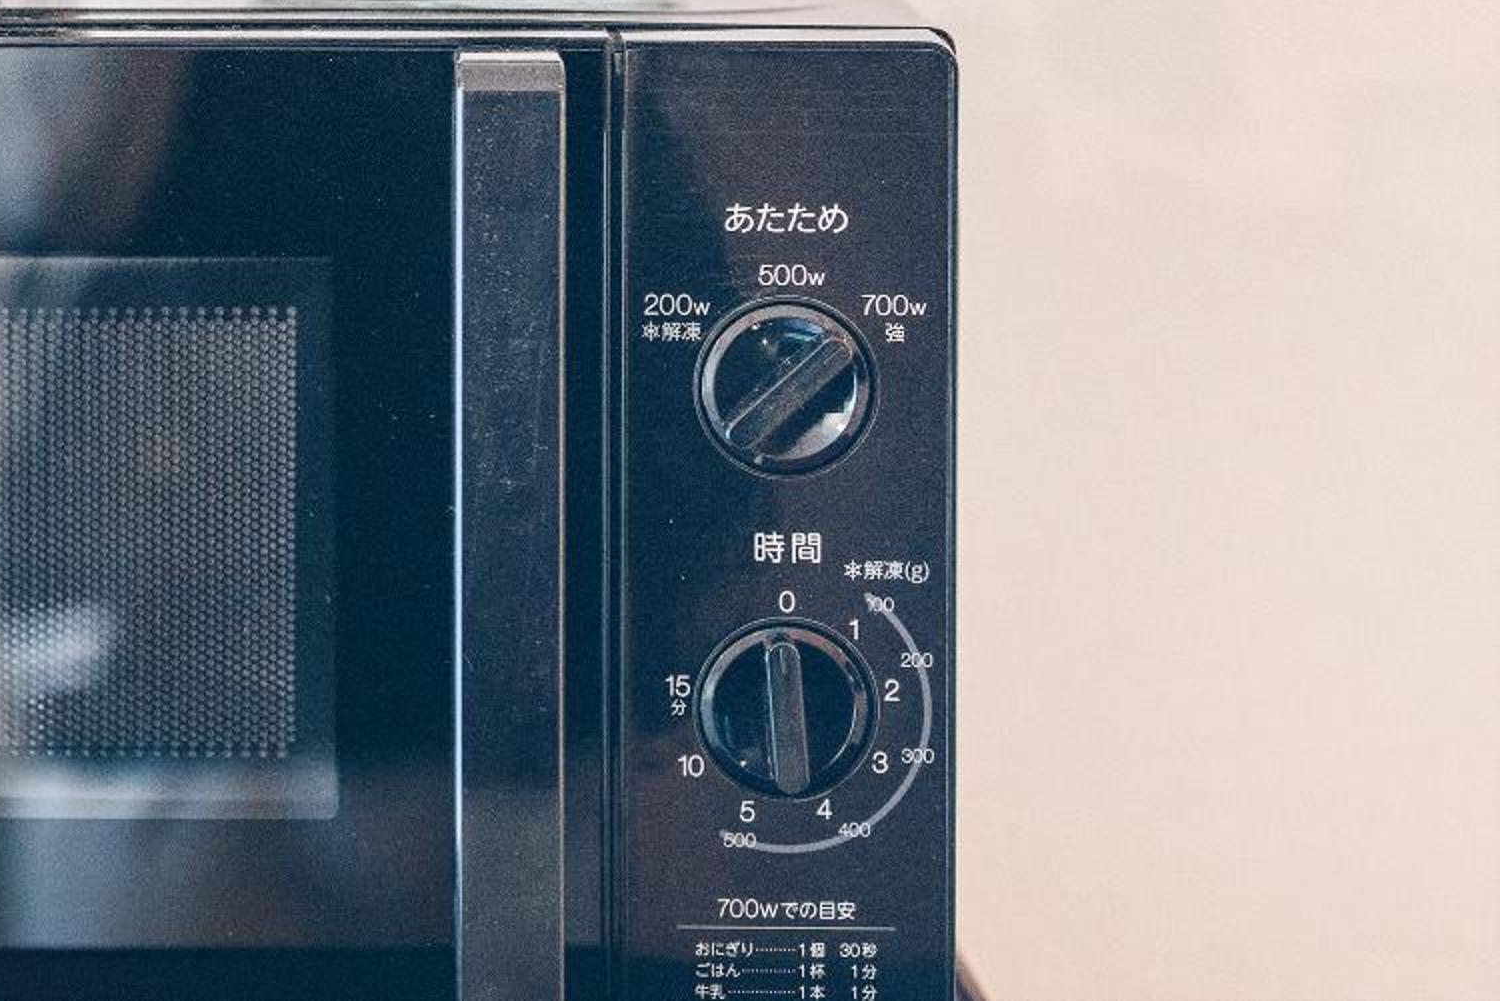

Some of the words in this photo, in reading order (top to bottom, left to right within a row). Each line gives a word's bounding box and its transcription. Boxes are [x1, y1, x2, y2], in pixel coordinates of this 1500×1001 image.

[725, 202, 848, 233] あたため
[885, 323, 905, 343] 強
[754, 532, 821, 563] 時間
[779, 591, 795, 613] 0
[850, 619, 860, 640] 1
[901, 653, 932, 667] 200
[666, 675, 690, 697] 15
[884, 680, 899, 702] 2
[671, 699, 687, 716] 分
[871, 751, 889, 774] 3
[902, 749, 933, 763] 300
[678, 756, 704, 777] 10
[741, 801, 755, 821] 5
[816, 799, 832, 819] 4
[839, 822, 870, 837] 400
[724, 833, 756, 847] 500
[839, 943, 878, 959] 30秒
[695, 963, 740, 978] ごはん
